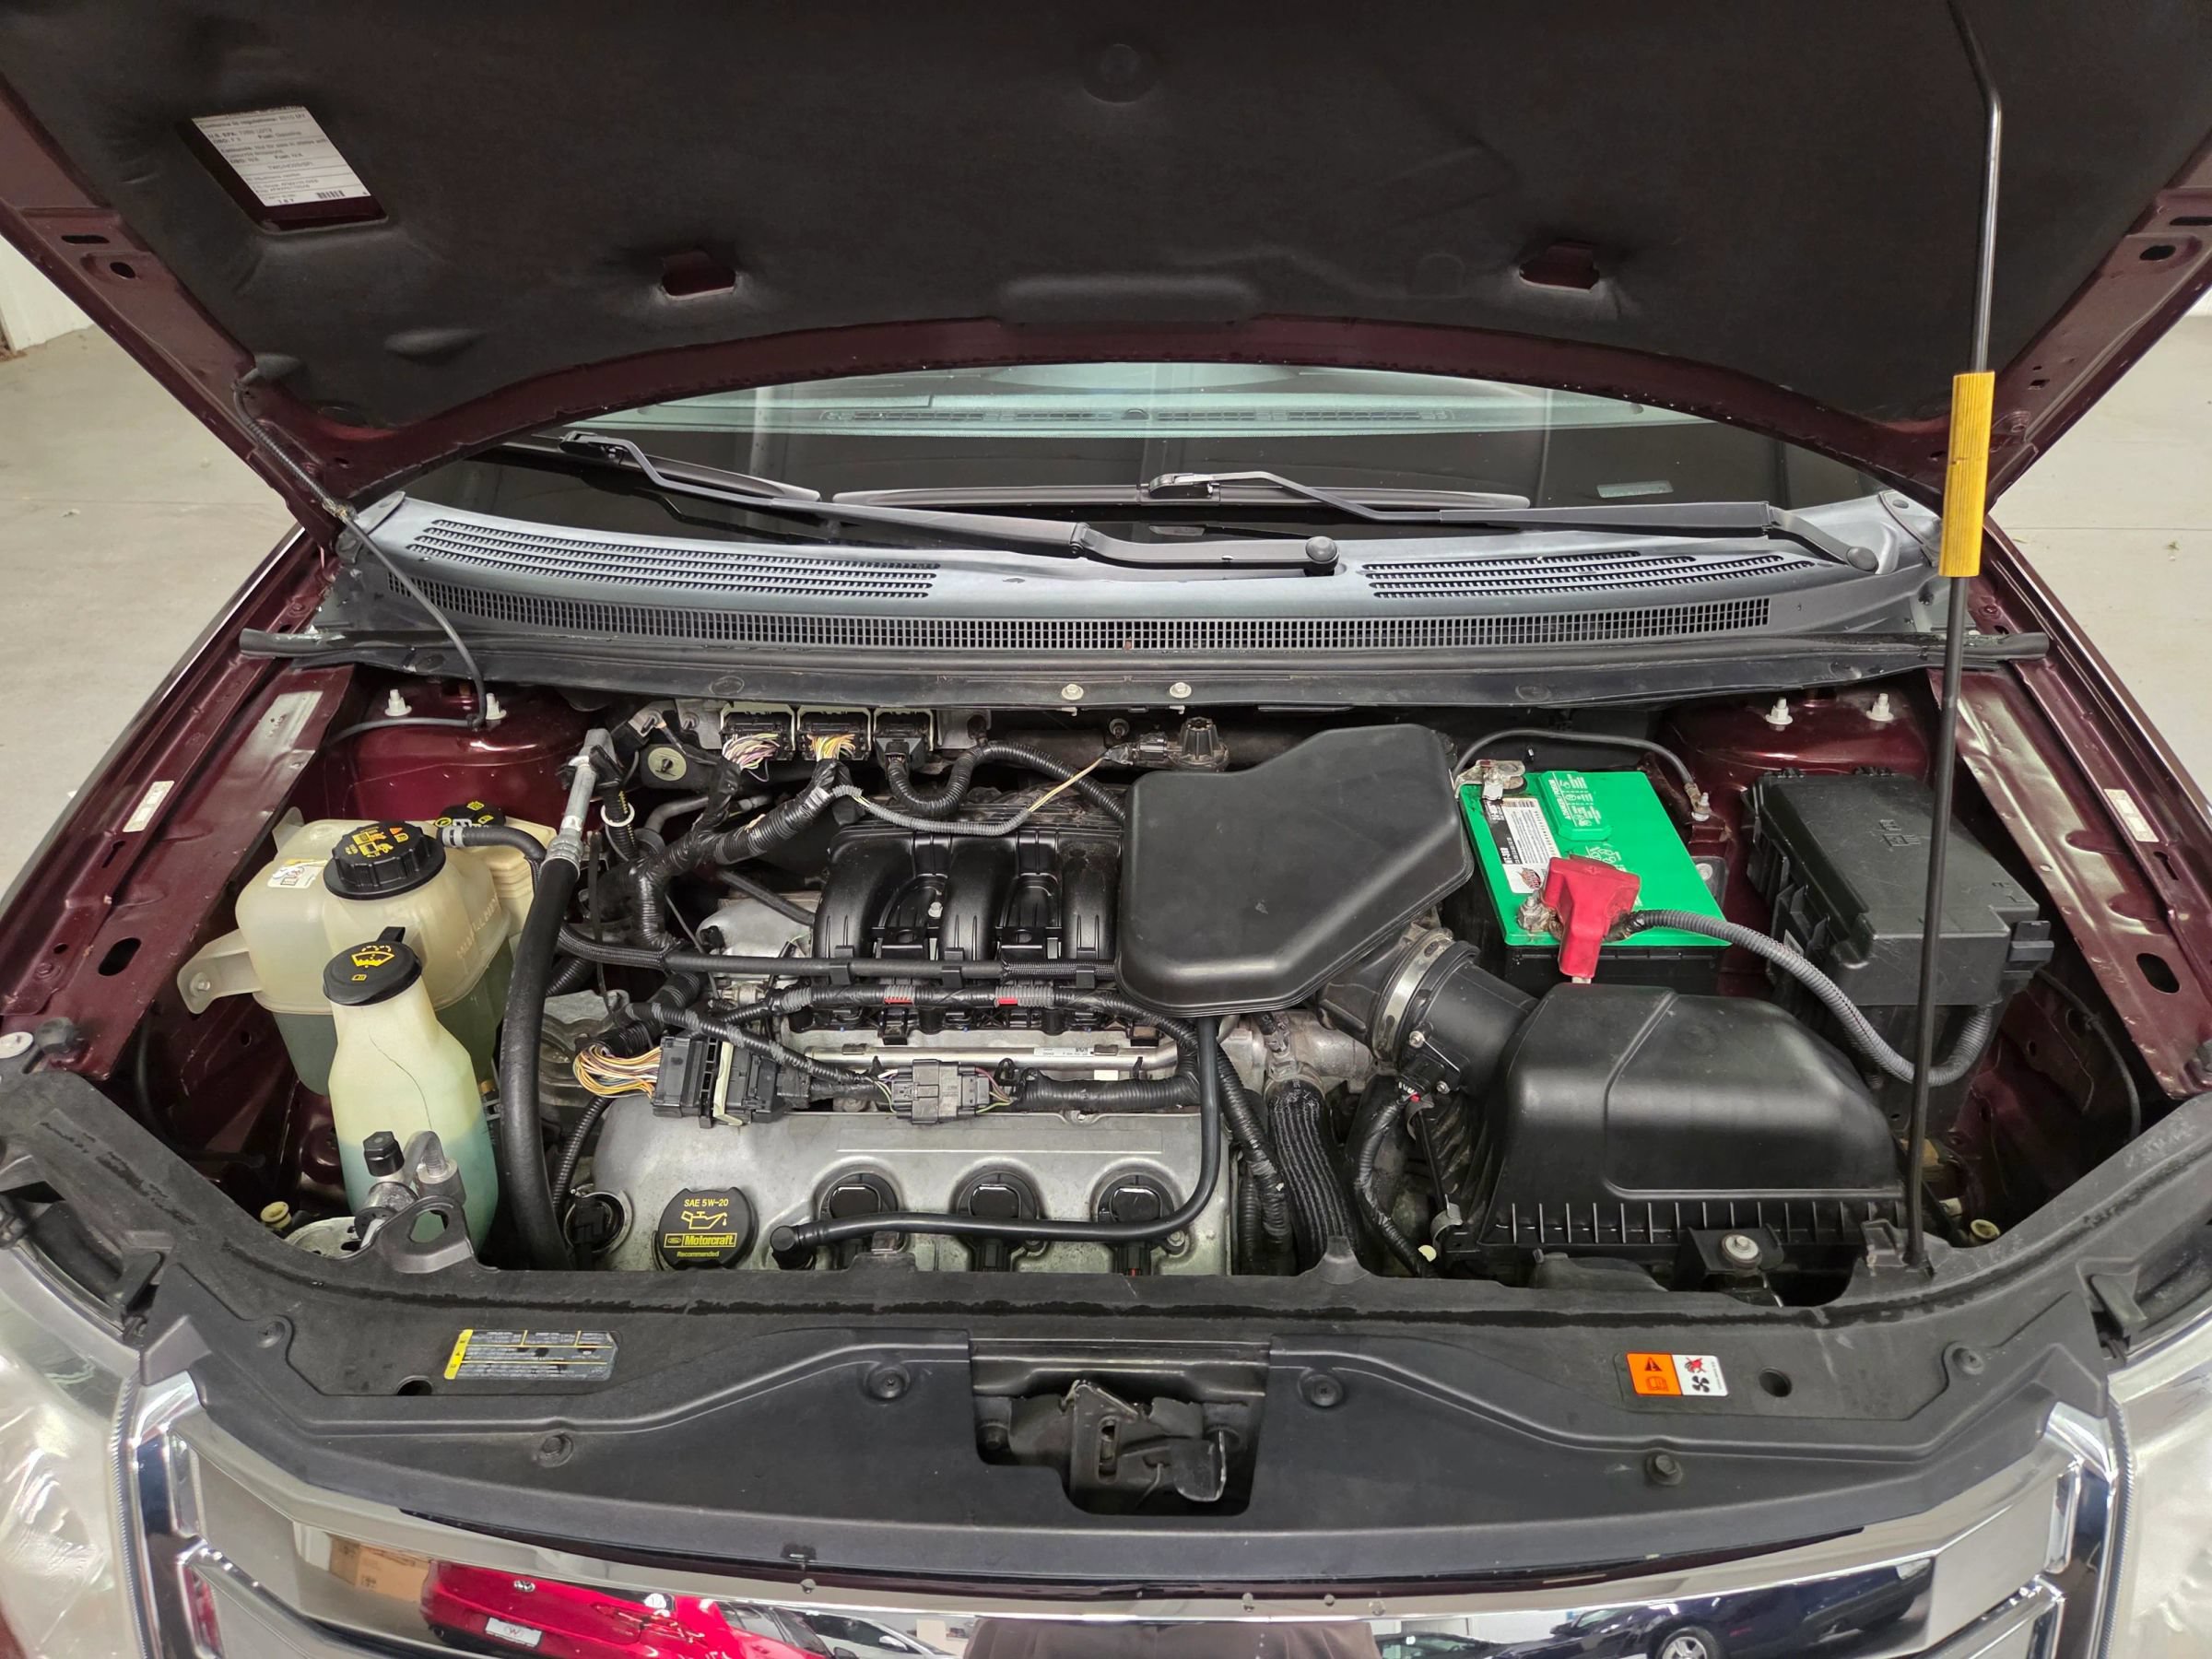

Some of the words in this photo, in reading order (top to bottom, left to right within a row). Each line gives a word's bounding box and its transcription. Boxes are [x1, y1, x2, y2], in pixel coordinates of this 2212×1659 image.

[684, 1199, 701, 1207] SAE
[701, 1198, 729, 1207] 5W-20
[685, 1235, 734, 1246] Motorcraft
